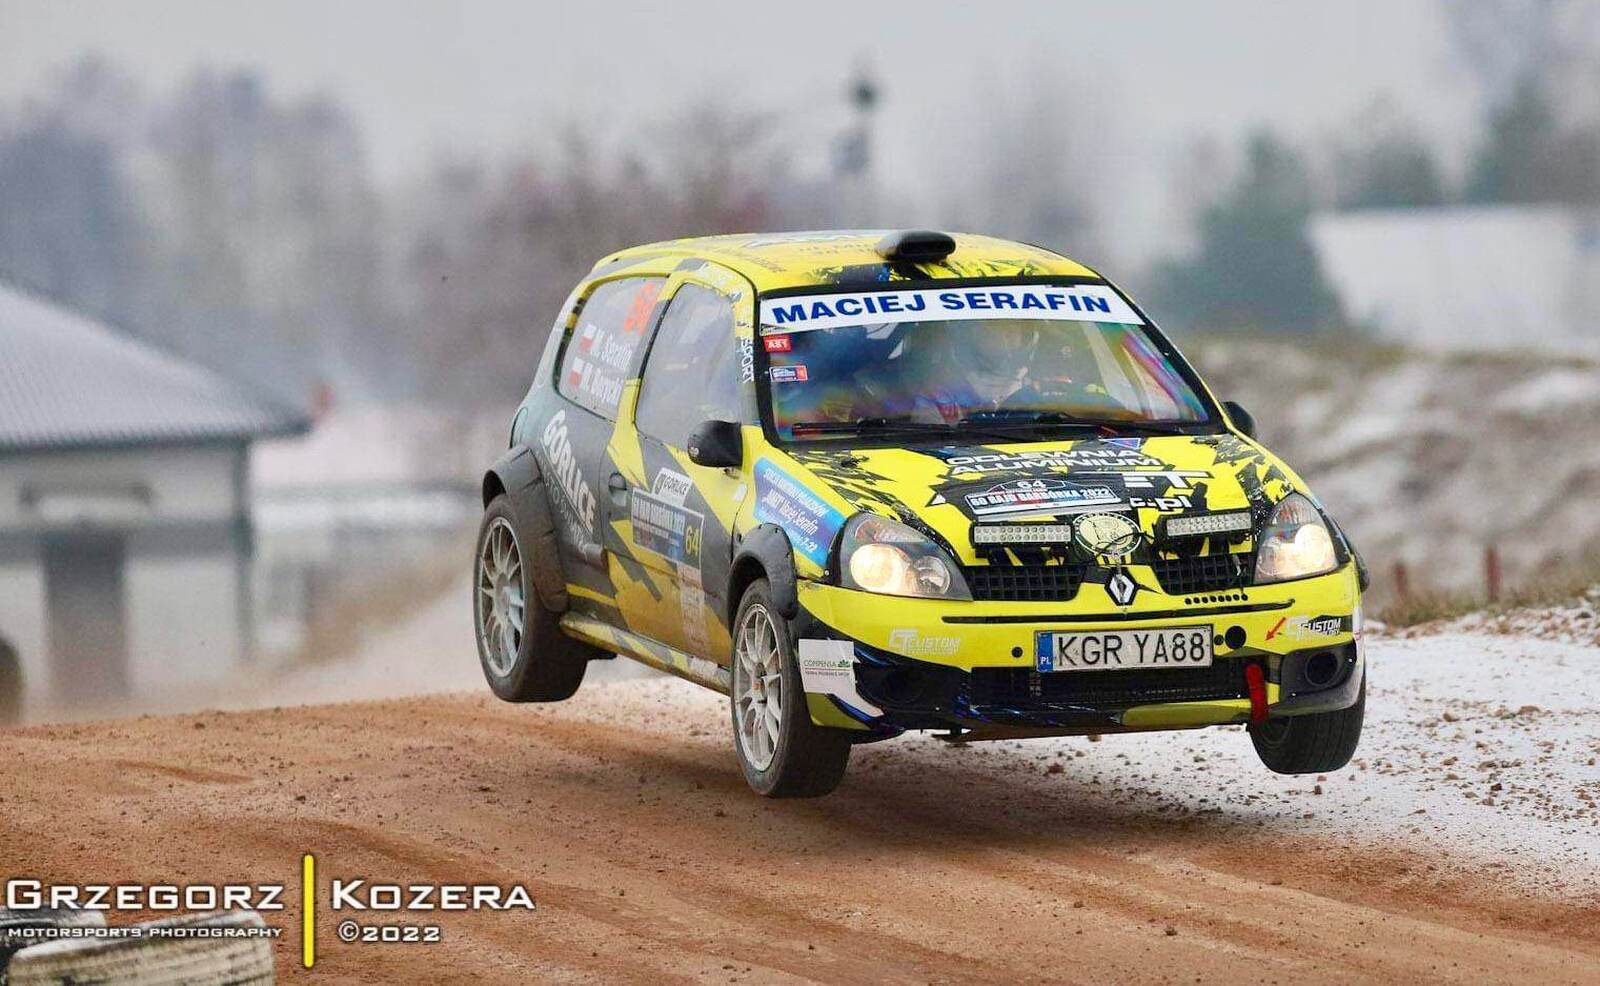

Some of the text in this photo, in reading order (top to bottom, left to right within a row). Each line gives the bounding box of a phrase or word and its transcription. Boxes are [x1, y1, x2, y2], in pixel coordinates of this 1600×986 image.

[772, 292, 1112, 324] MACIEJ SERAFIN
[739, 338, 754, 384] SPORT
[544, 410, 597, 534] GORLICE
[946, 449, 1145, 466] ODLEWNIA
[951, 458, 1161, 475] ALUMINIUM
[1016, 479, 1047, 489] 64
[686, 525, 700, 555] 64
[1039, 631, 1206, 667] PL KGR YA88
